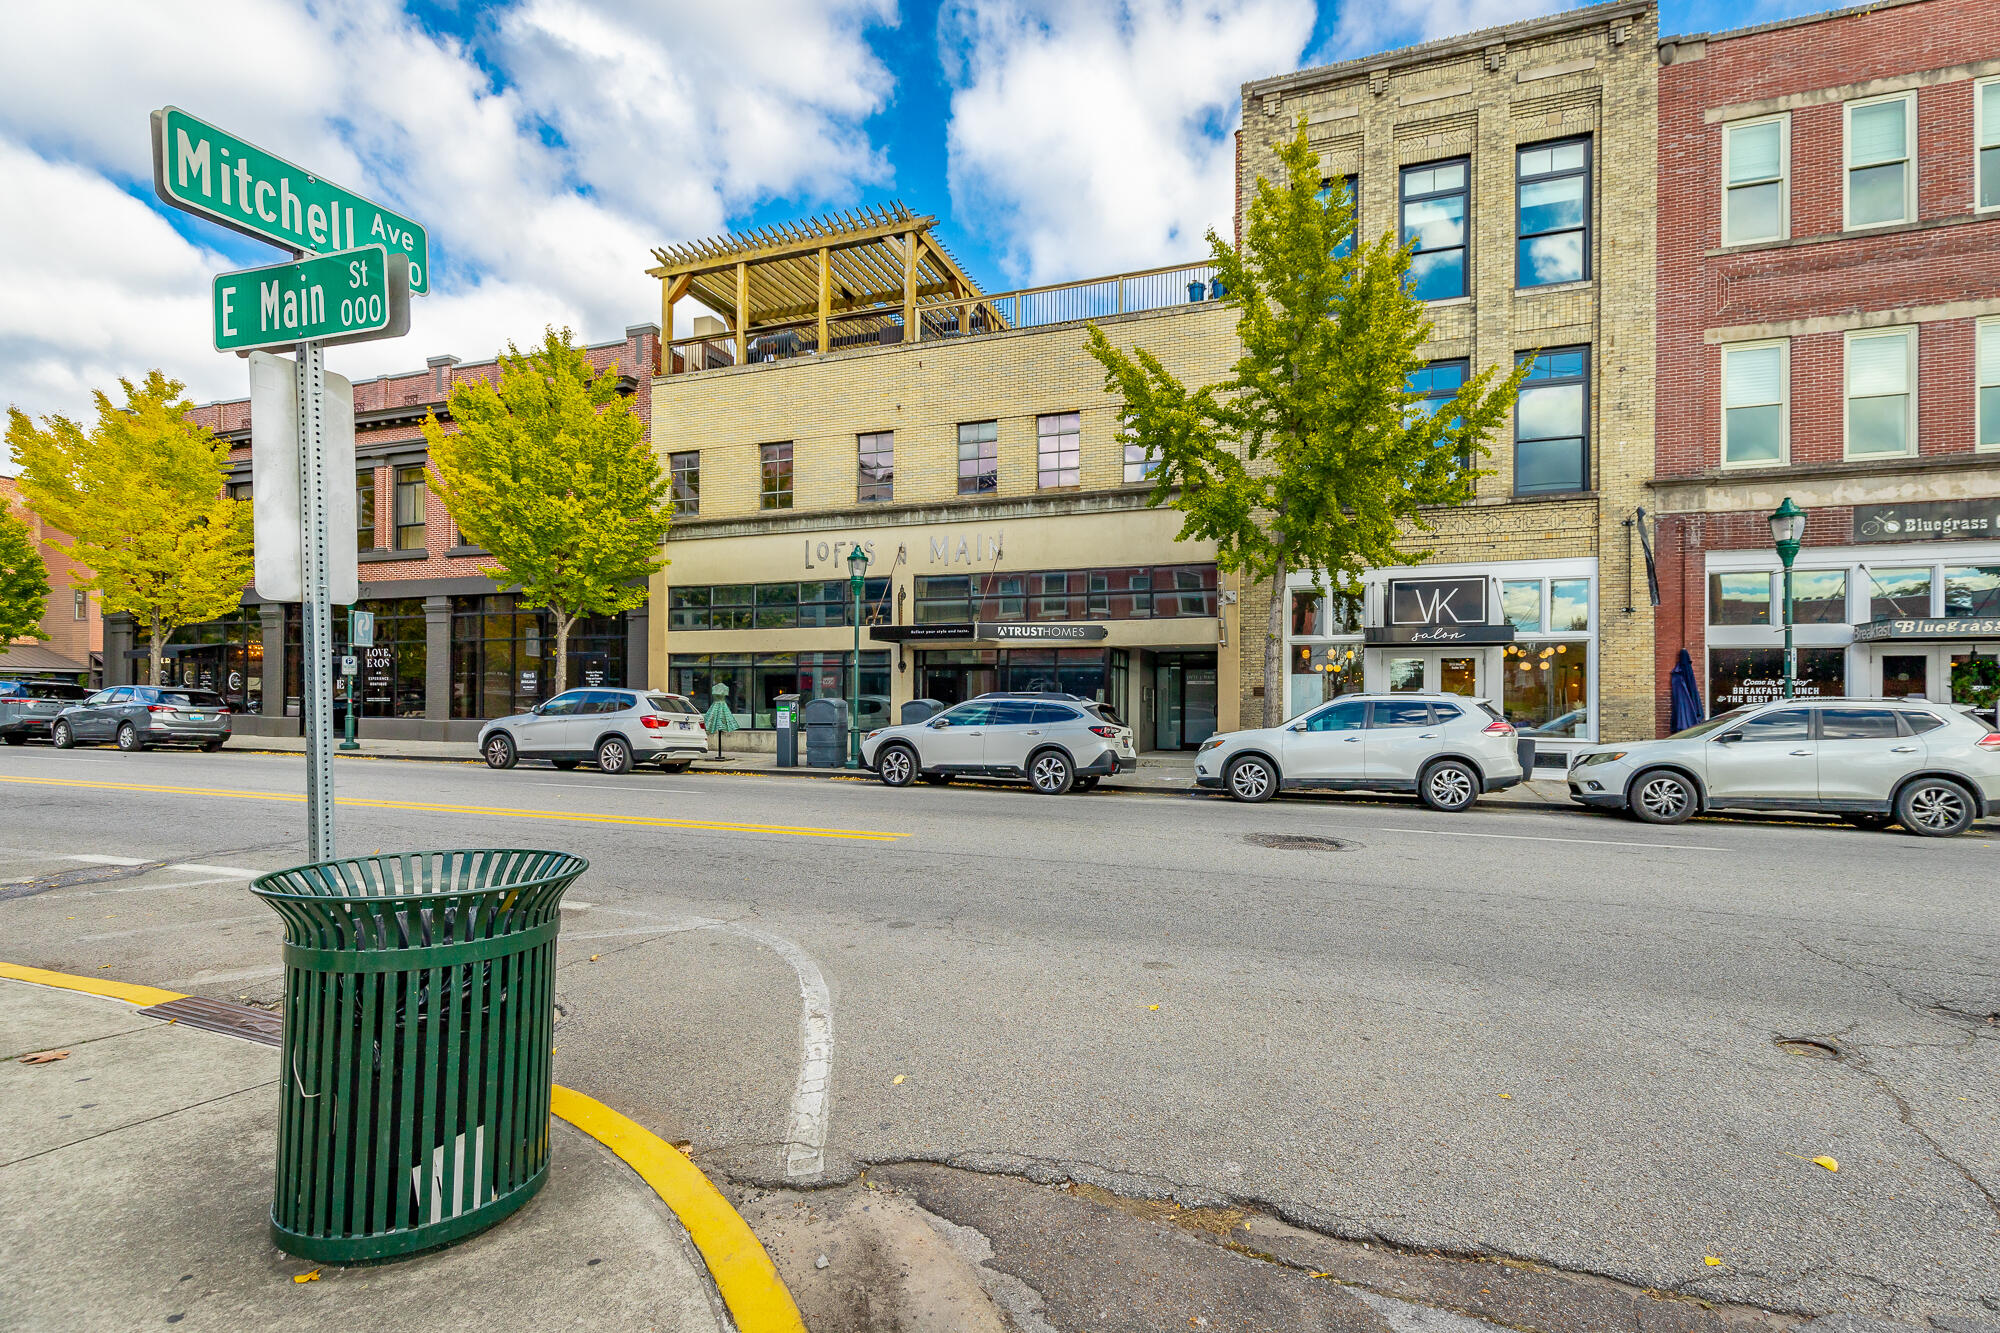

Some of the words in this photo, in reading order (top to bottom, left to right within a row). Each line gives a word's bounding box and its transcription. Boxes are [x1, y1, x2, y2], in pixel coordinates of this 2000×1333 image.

[176, 127, 355, 251] Mitchell
[370, 212, 414, 252] Ave
[222, 286, 238, 337] E
[260, 274, 326, 332] Main
[349, 260, 369, 289] St
[340, 294, 382, 327] 000
[1904, 517, 1989, 534] Bluegrass
[929, 527, 1004, 567] MAIN
[1415, 587, 1459, 624] VK
[1411, 627, 1467, 642] salon
[1853, 623, 1893, 641] Breakfast
[366, 658, 390, 668] EROS
[1743, 678, 1766, 687] Come
[1789, 678, 1813, 688] njoy
[1727, 695, 1744, 703] THE
[1746, 695, 1770, 703] BEST
